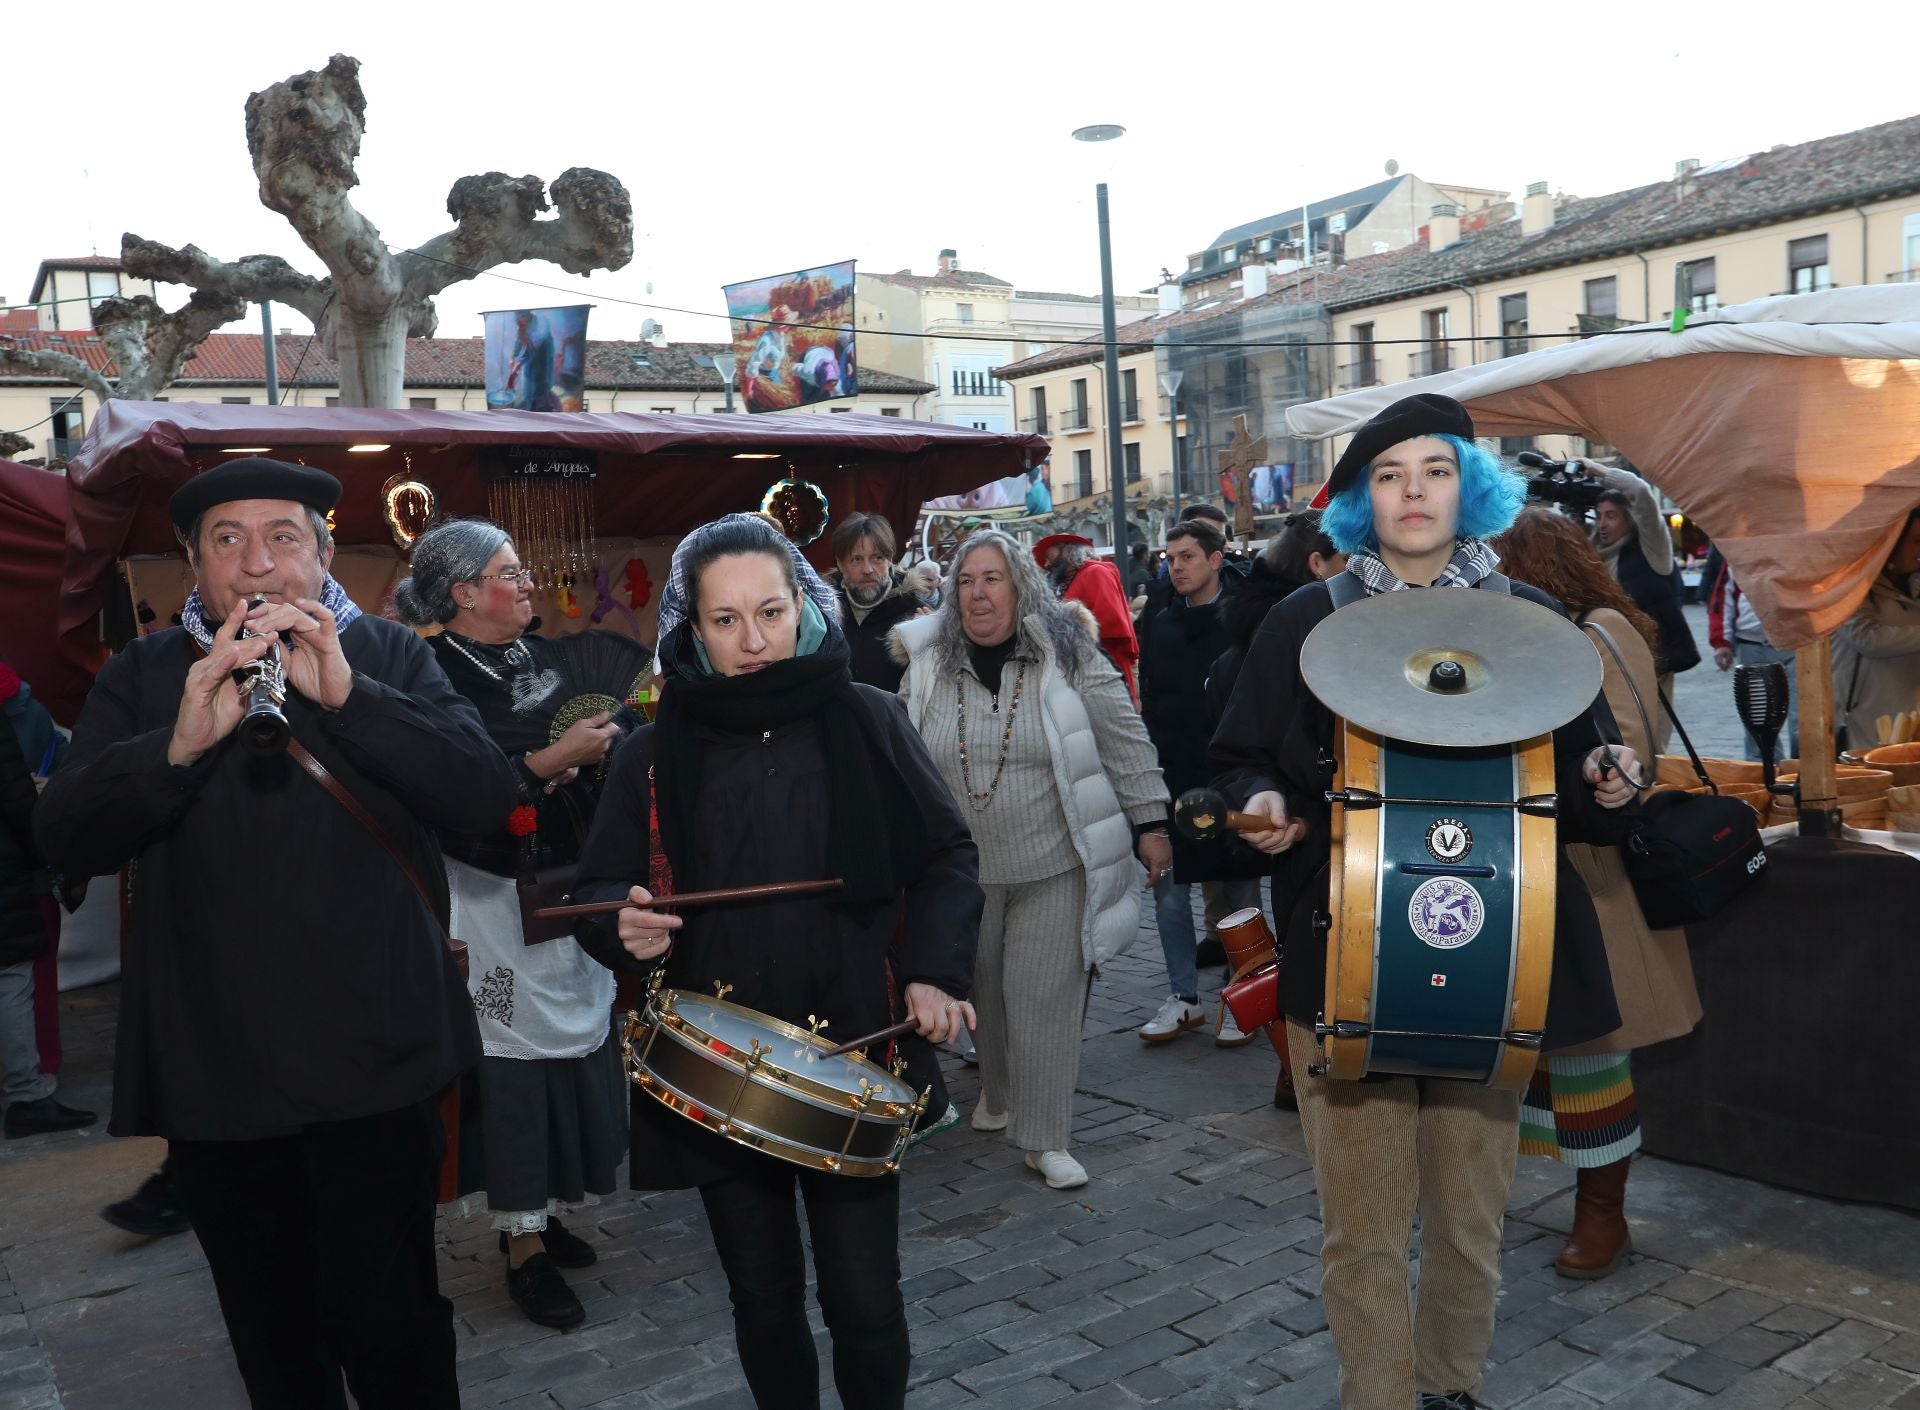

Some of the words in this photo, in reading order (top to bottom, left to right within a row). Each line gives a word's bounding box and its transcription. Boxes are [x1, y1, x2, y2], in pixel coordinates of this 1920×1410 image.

[524, 459, 538, 473] de
[1430, 818, 1468, 833] VEREDA
[1427, 846, 1450, 863] CERVEZA
[1451, 850, 1469, 863] RURAL
[1747, 850, 1767, 874] EOS
